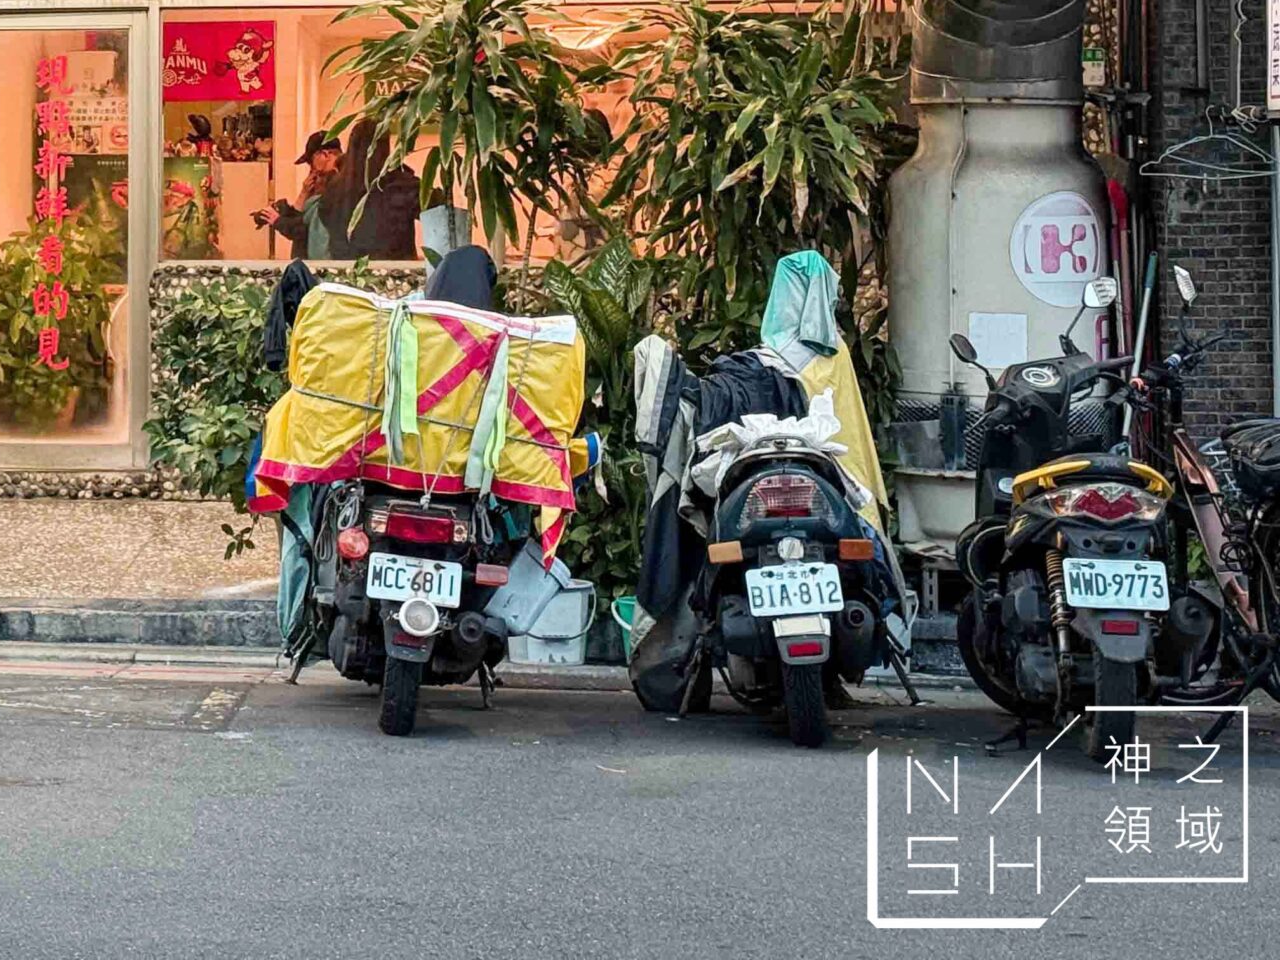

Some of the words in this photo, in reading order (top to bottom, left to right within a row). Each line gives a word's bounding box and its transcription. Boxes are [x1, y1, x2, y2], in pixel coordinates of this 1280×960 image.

[33, 55, 74, 370] 現點新鮮看的見
